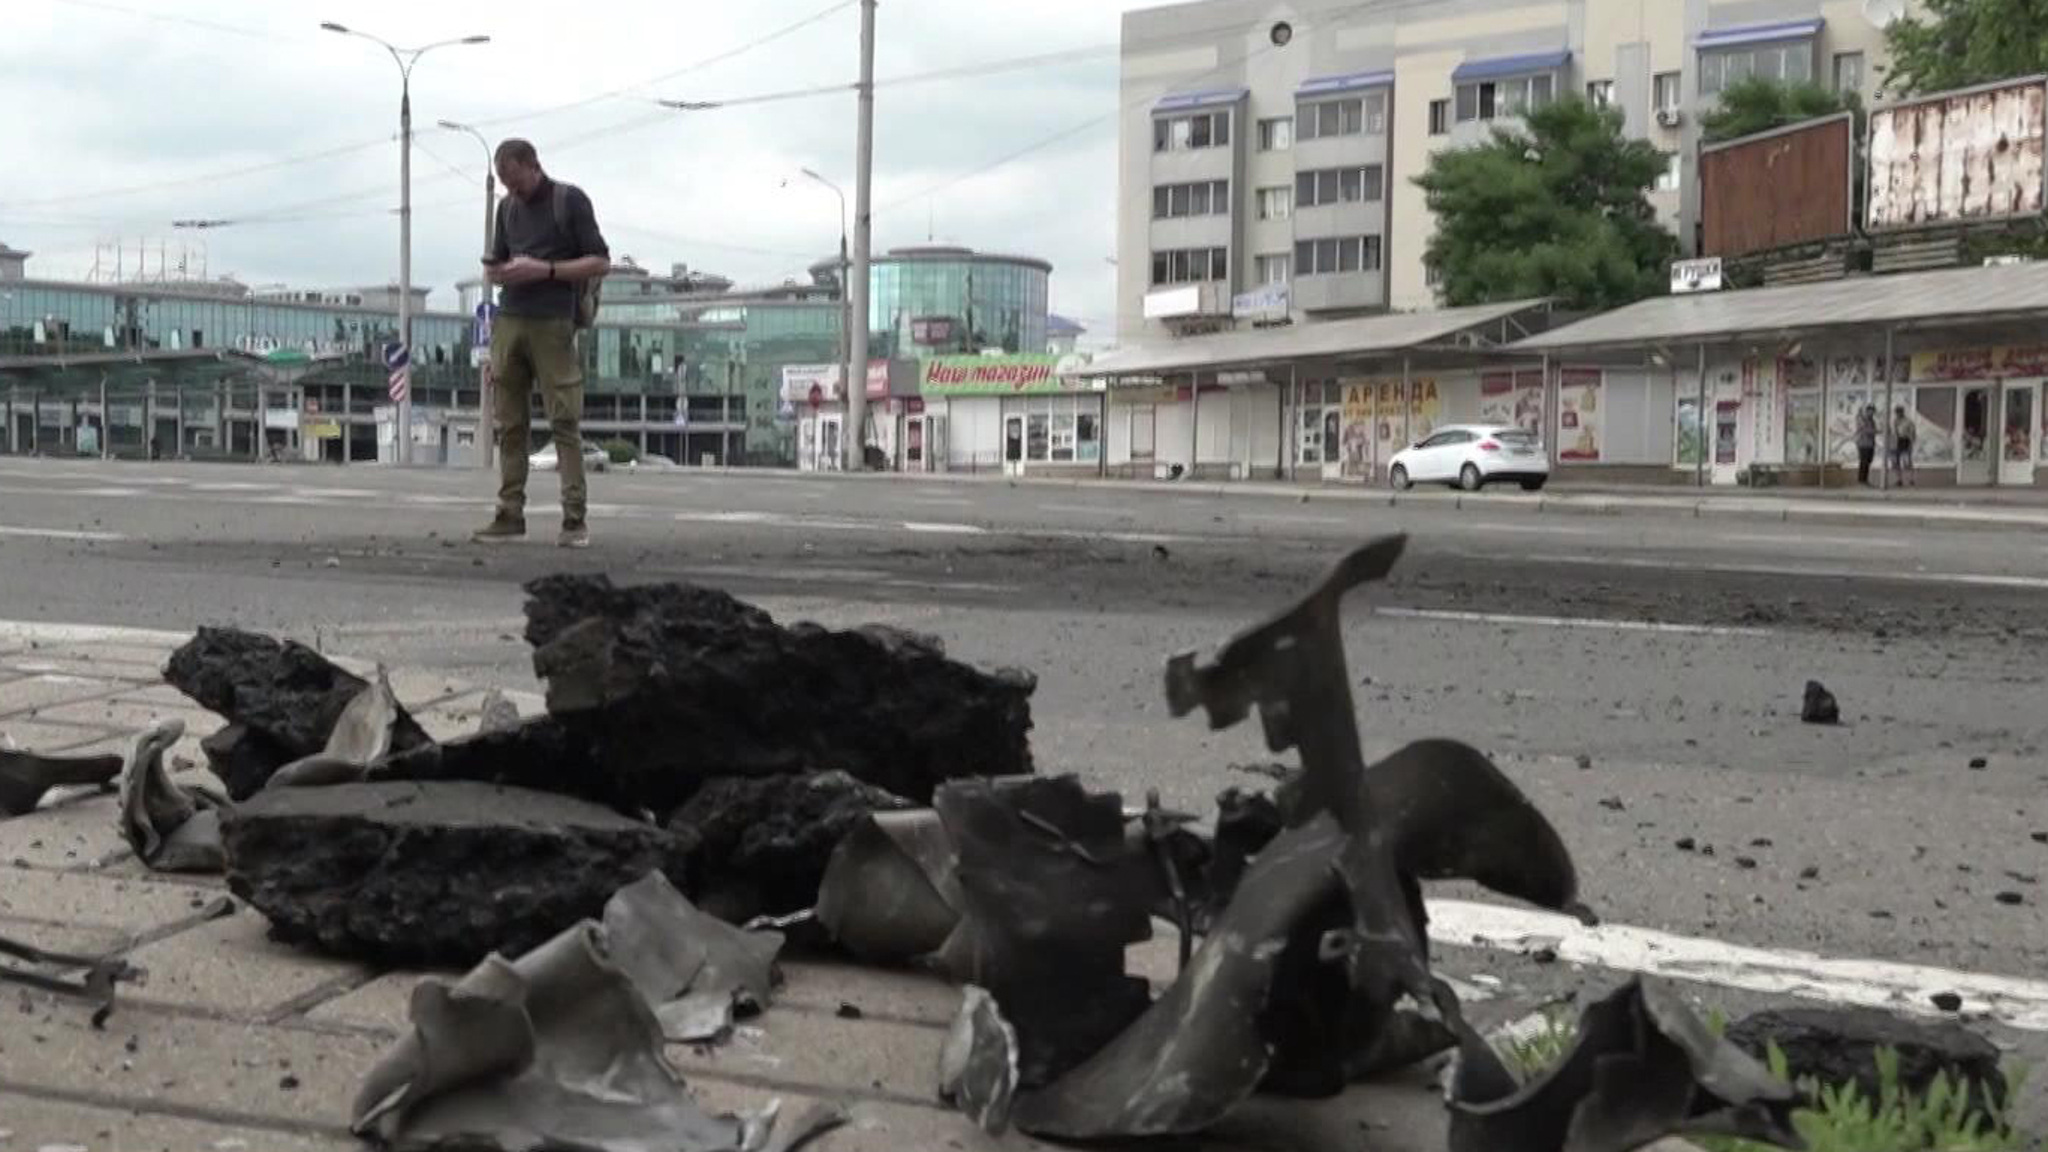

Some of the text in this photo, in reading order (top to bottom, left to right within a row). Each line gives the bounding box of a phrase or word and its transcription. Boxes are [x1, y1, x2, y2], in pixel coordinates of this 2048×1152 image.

[927, 361, 1051, 389] Наш магазин
[1349, 381, 1438, 403] АРЕНДА
